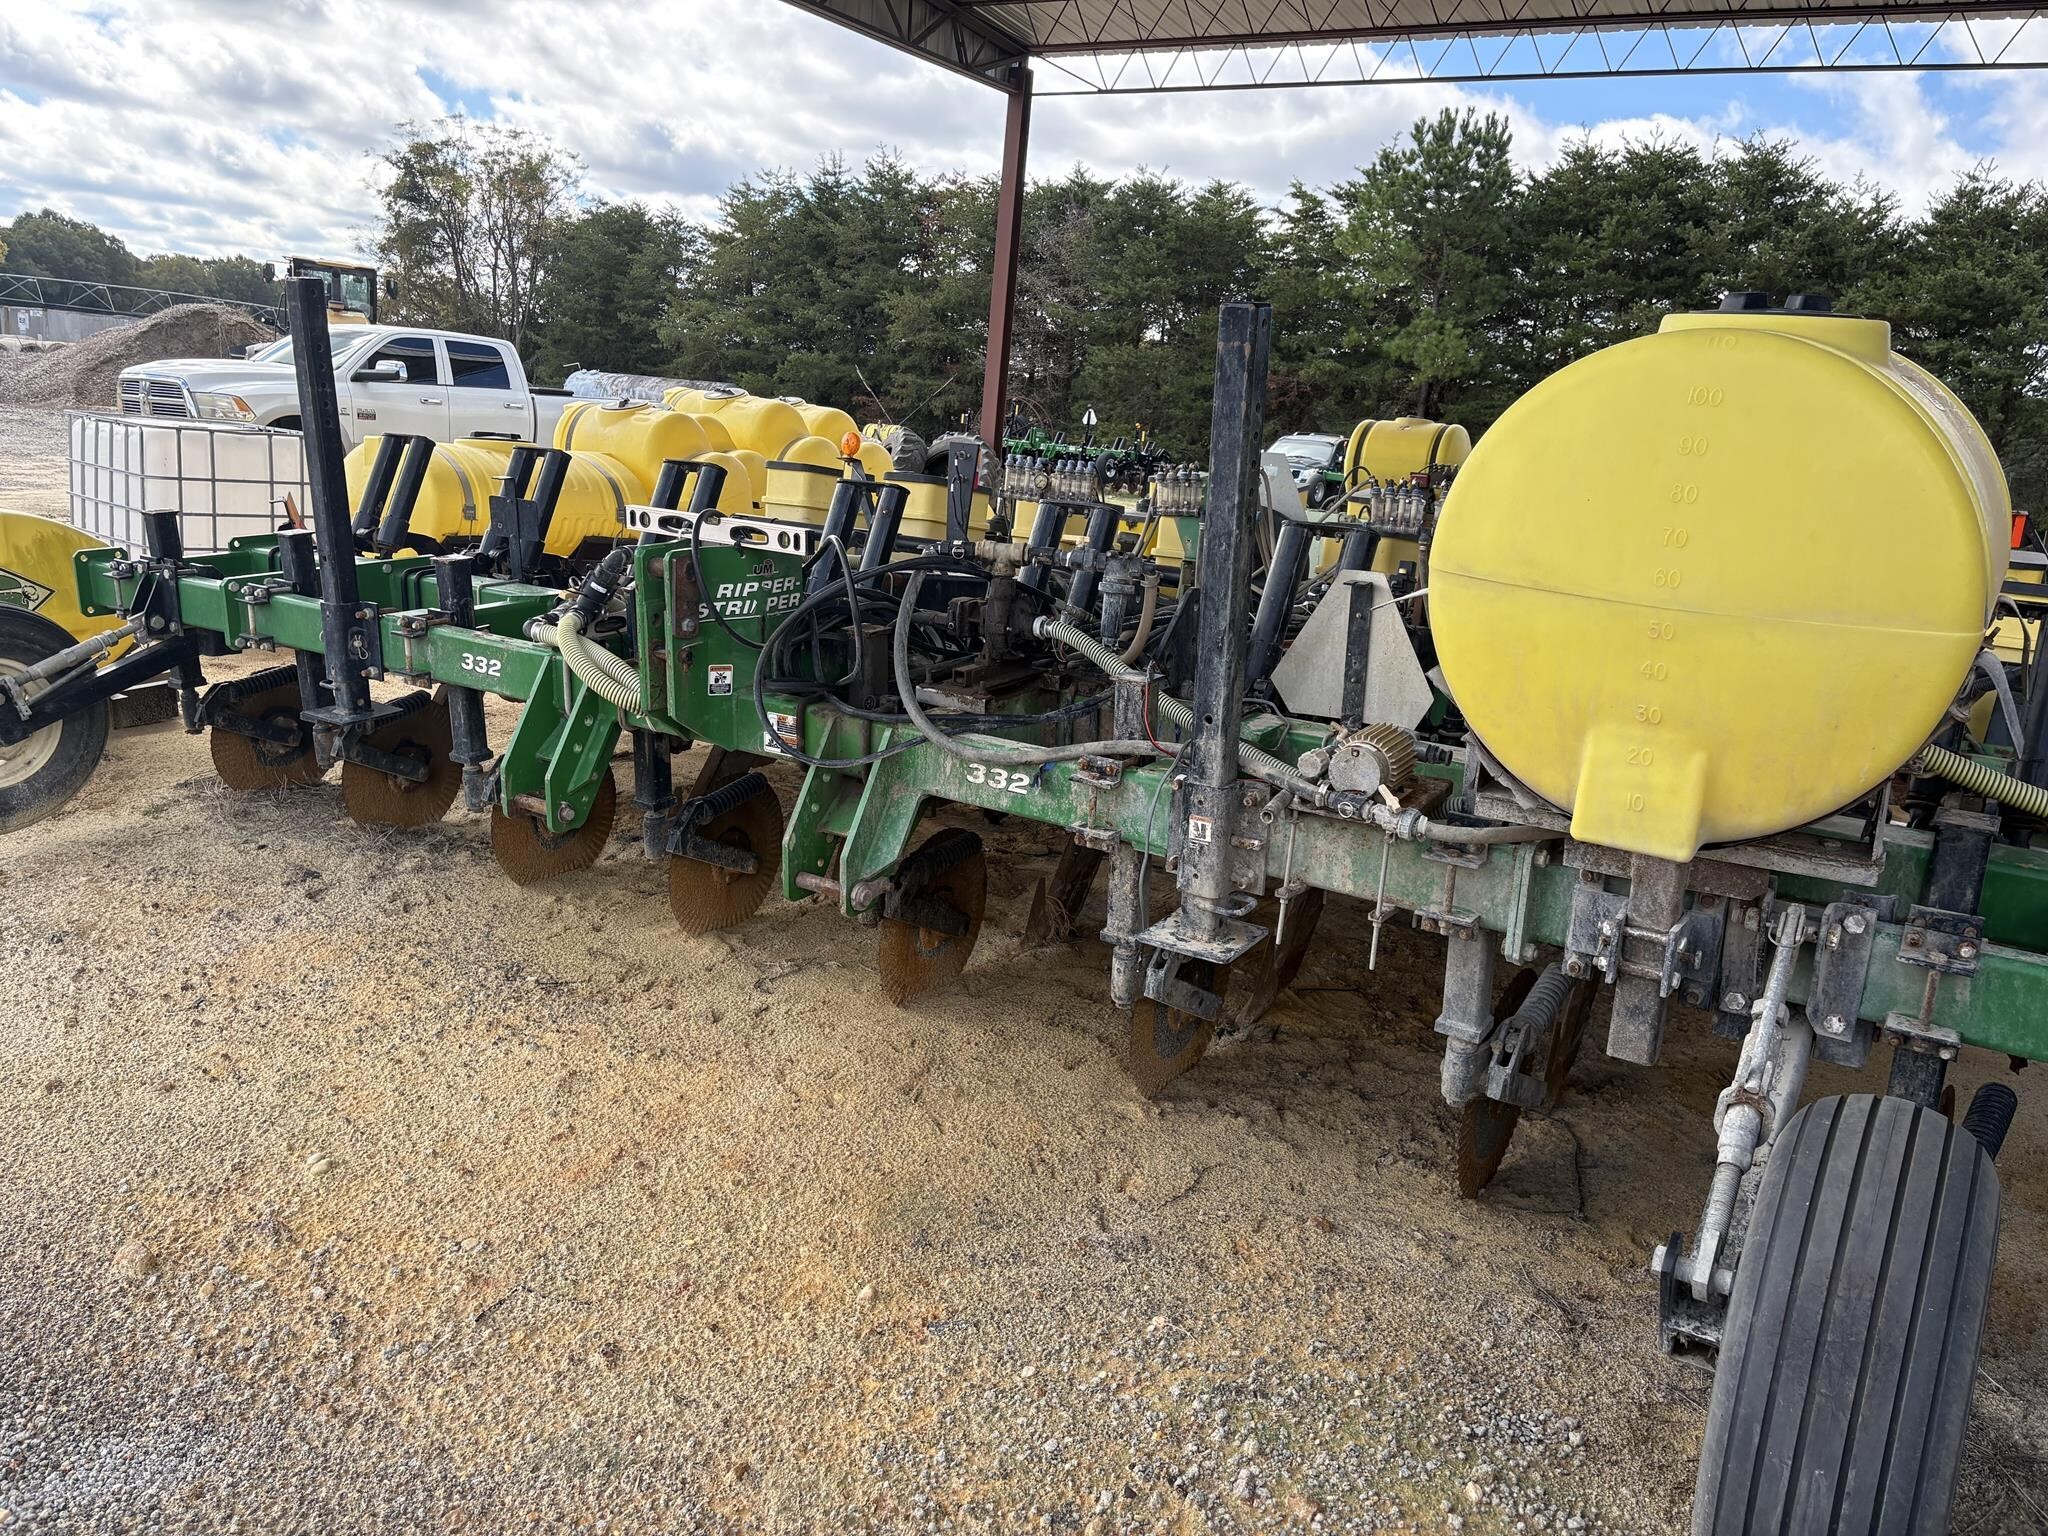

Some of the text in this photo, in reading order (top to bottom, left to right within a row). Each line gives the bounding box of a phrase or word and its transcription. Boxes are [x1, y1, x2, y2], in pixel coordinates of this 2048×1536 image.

[1687, 386, 1724, 407] 100
[1678, 434, 1709, 456] 90
[1671, 482, 1698, 504] 80
[1663, 527, 1689, 548] 70
[1653, 567, 1682, 588] 60
[1647, 620, 1674, 640] 50
[461, 652, 502, 677] 332
[1640, 661, 1668, 681] 40
[1635, 704, 1662, 725] 30
[1626, 747, 1654, 767] 20
[966, 763, 1030, 795] 332
[1626, 792, 1644, 812] 10
